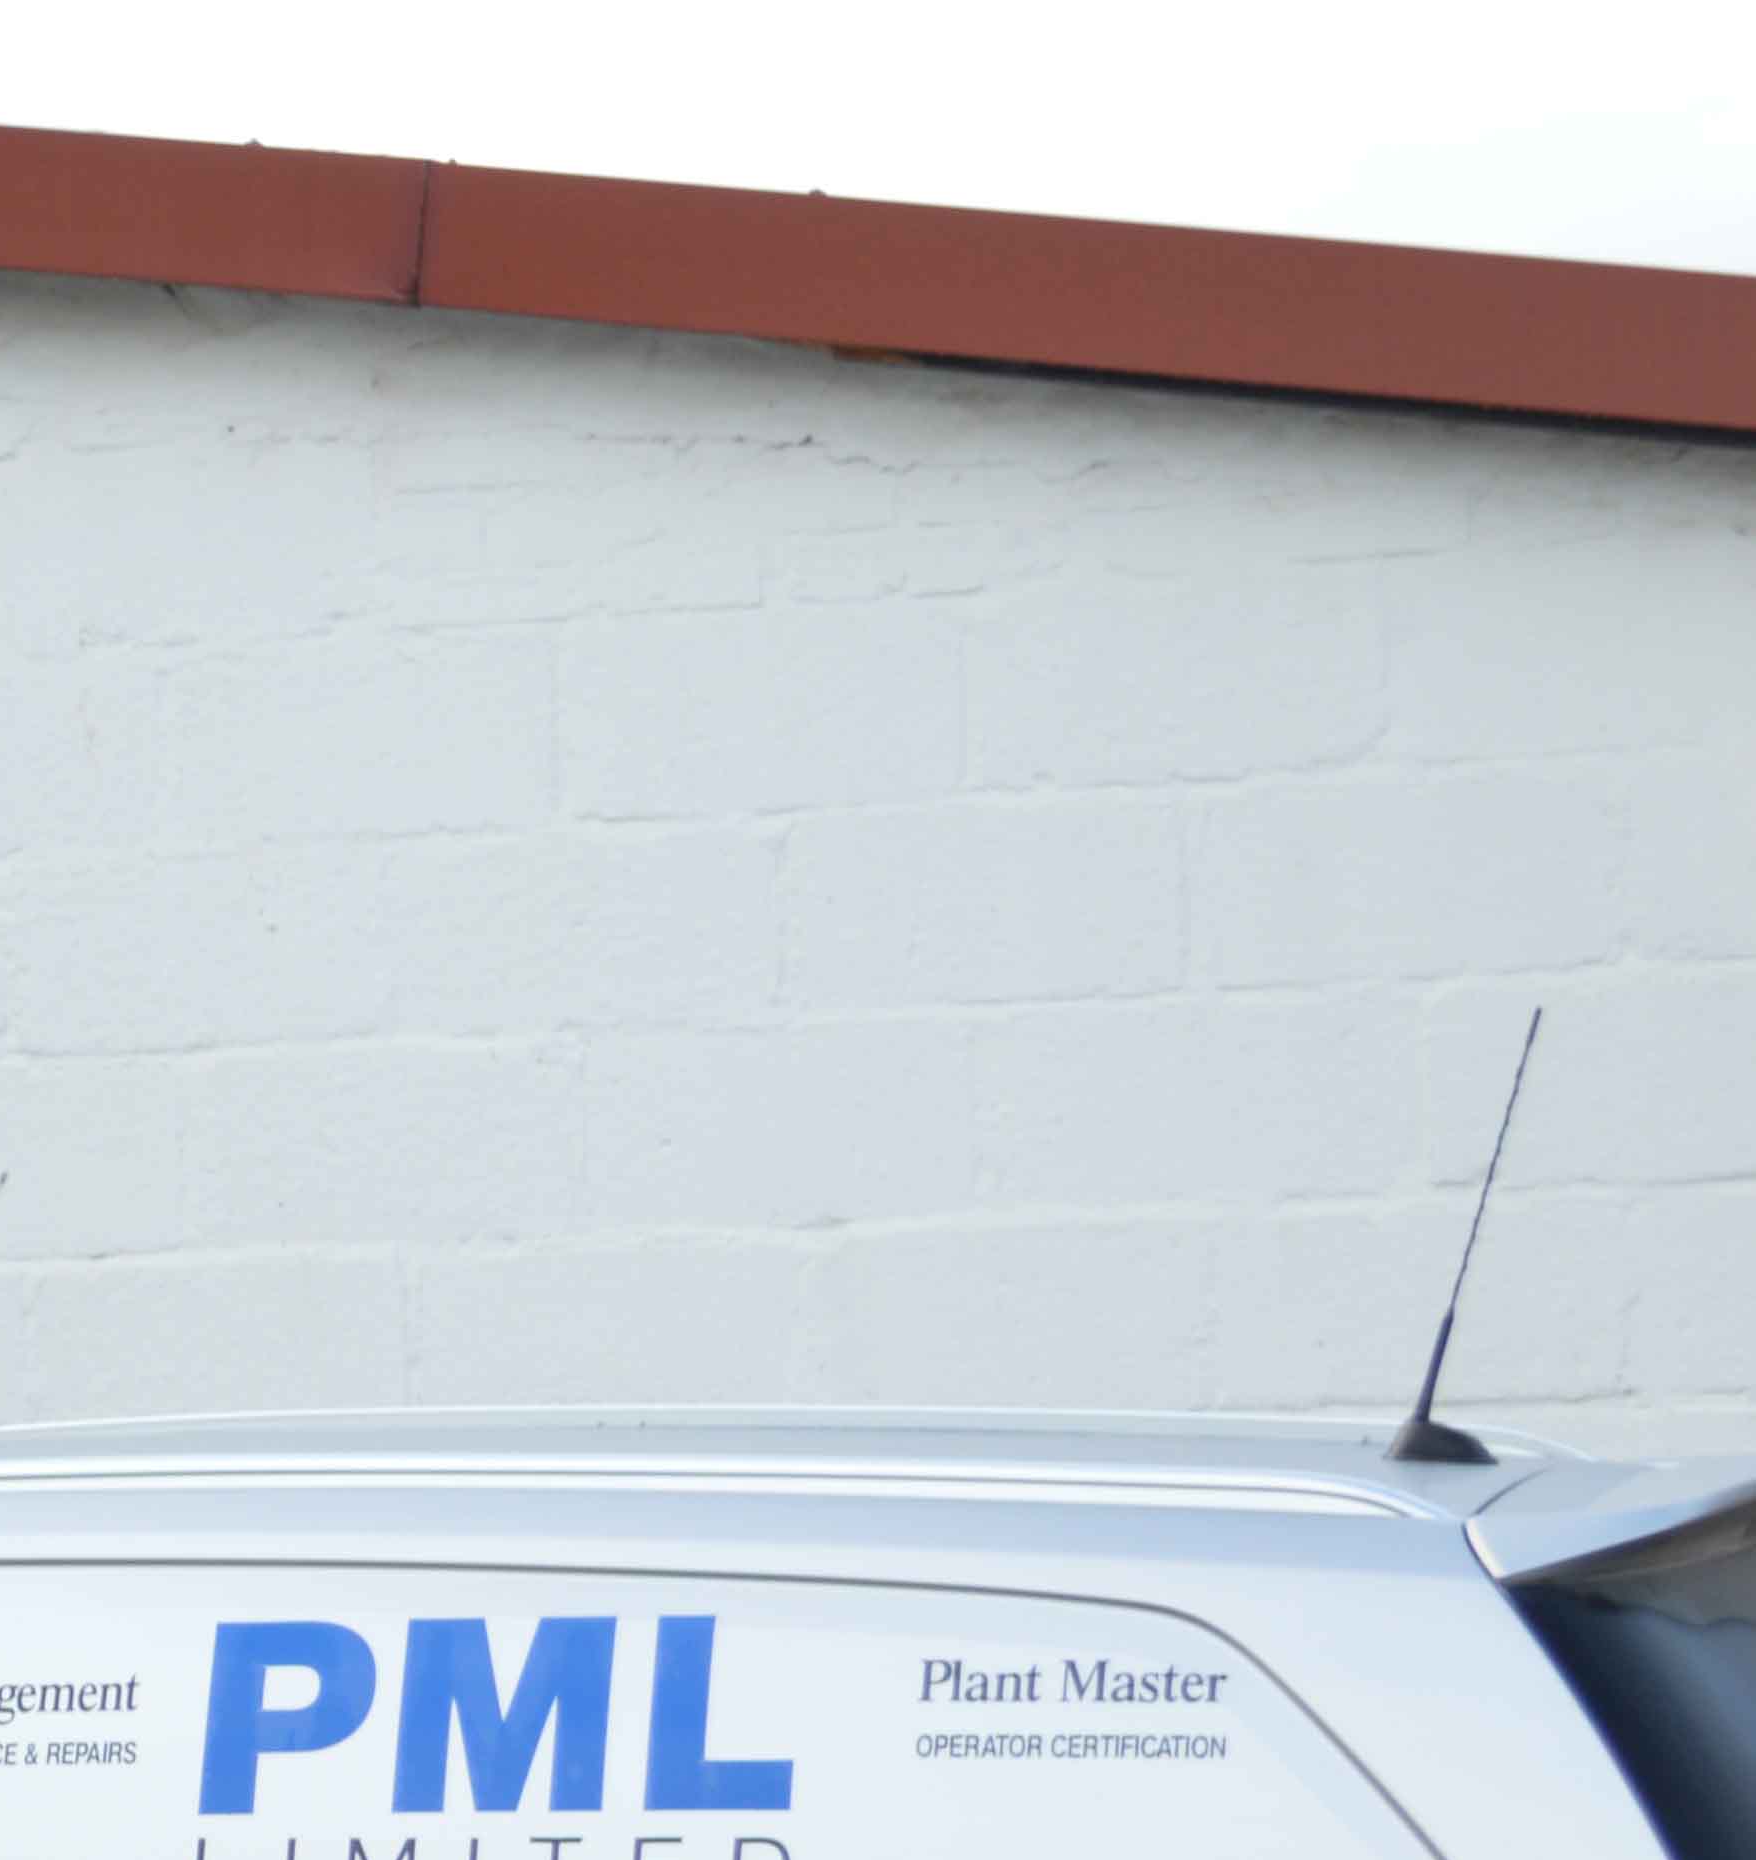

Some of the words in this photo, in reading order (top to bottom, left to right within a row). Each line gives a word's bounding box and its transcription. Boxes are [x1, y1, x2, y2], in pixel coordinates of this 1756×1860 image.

[919, 1658, 1041, 1703] Plant
[1060, 1658, 1229, 1703] Master
[198, 1615, 793, 1814] PML
[23, 1743, 39, 1765] &
[46, 1741, 137, 1765] REPAIRS
[915, 1733, 1043, 1758] OPERATOR
[1050, 1733, 1227, 1759] CERTIFICATION
